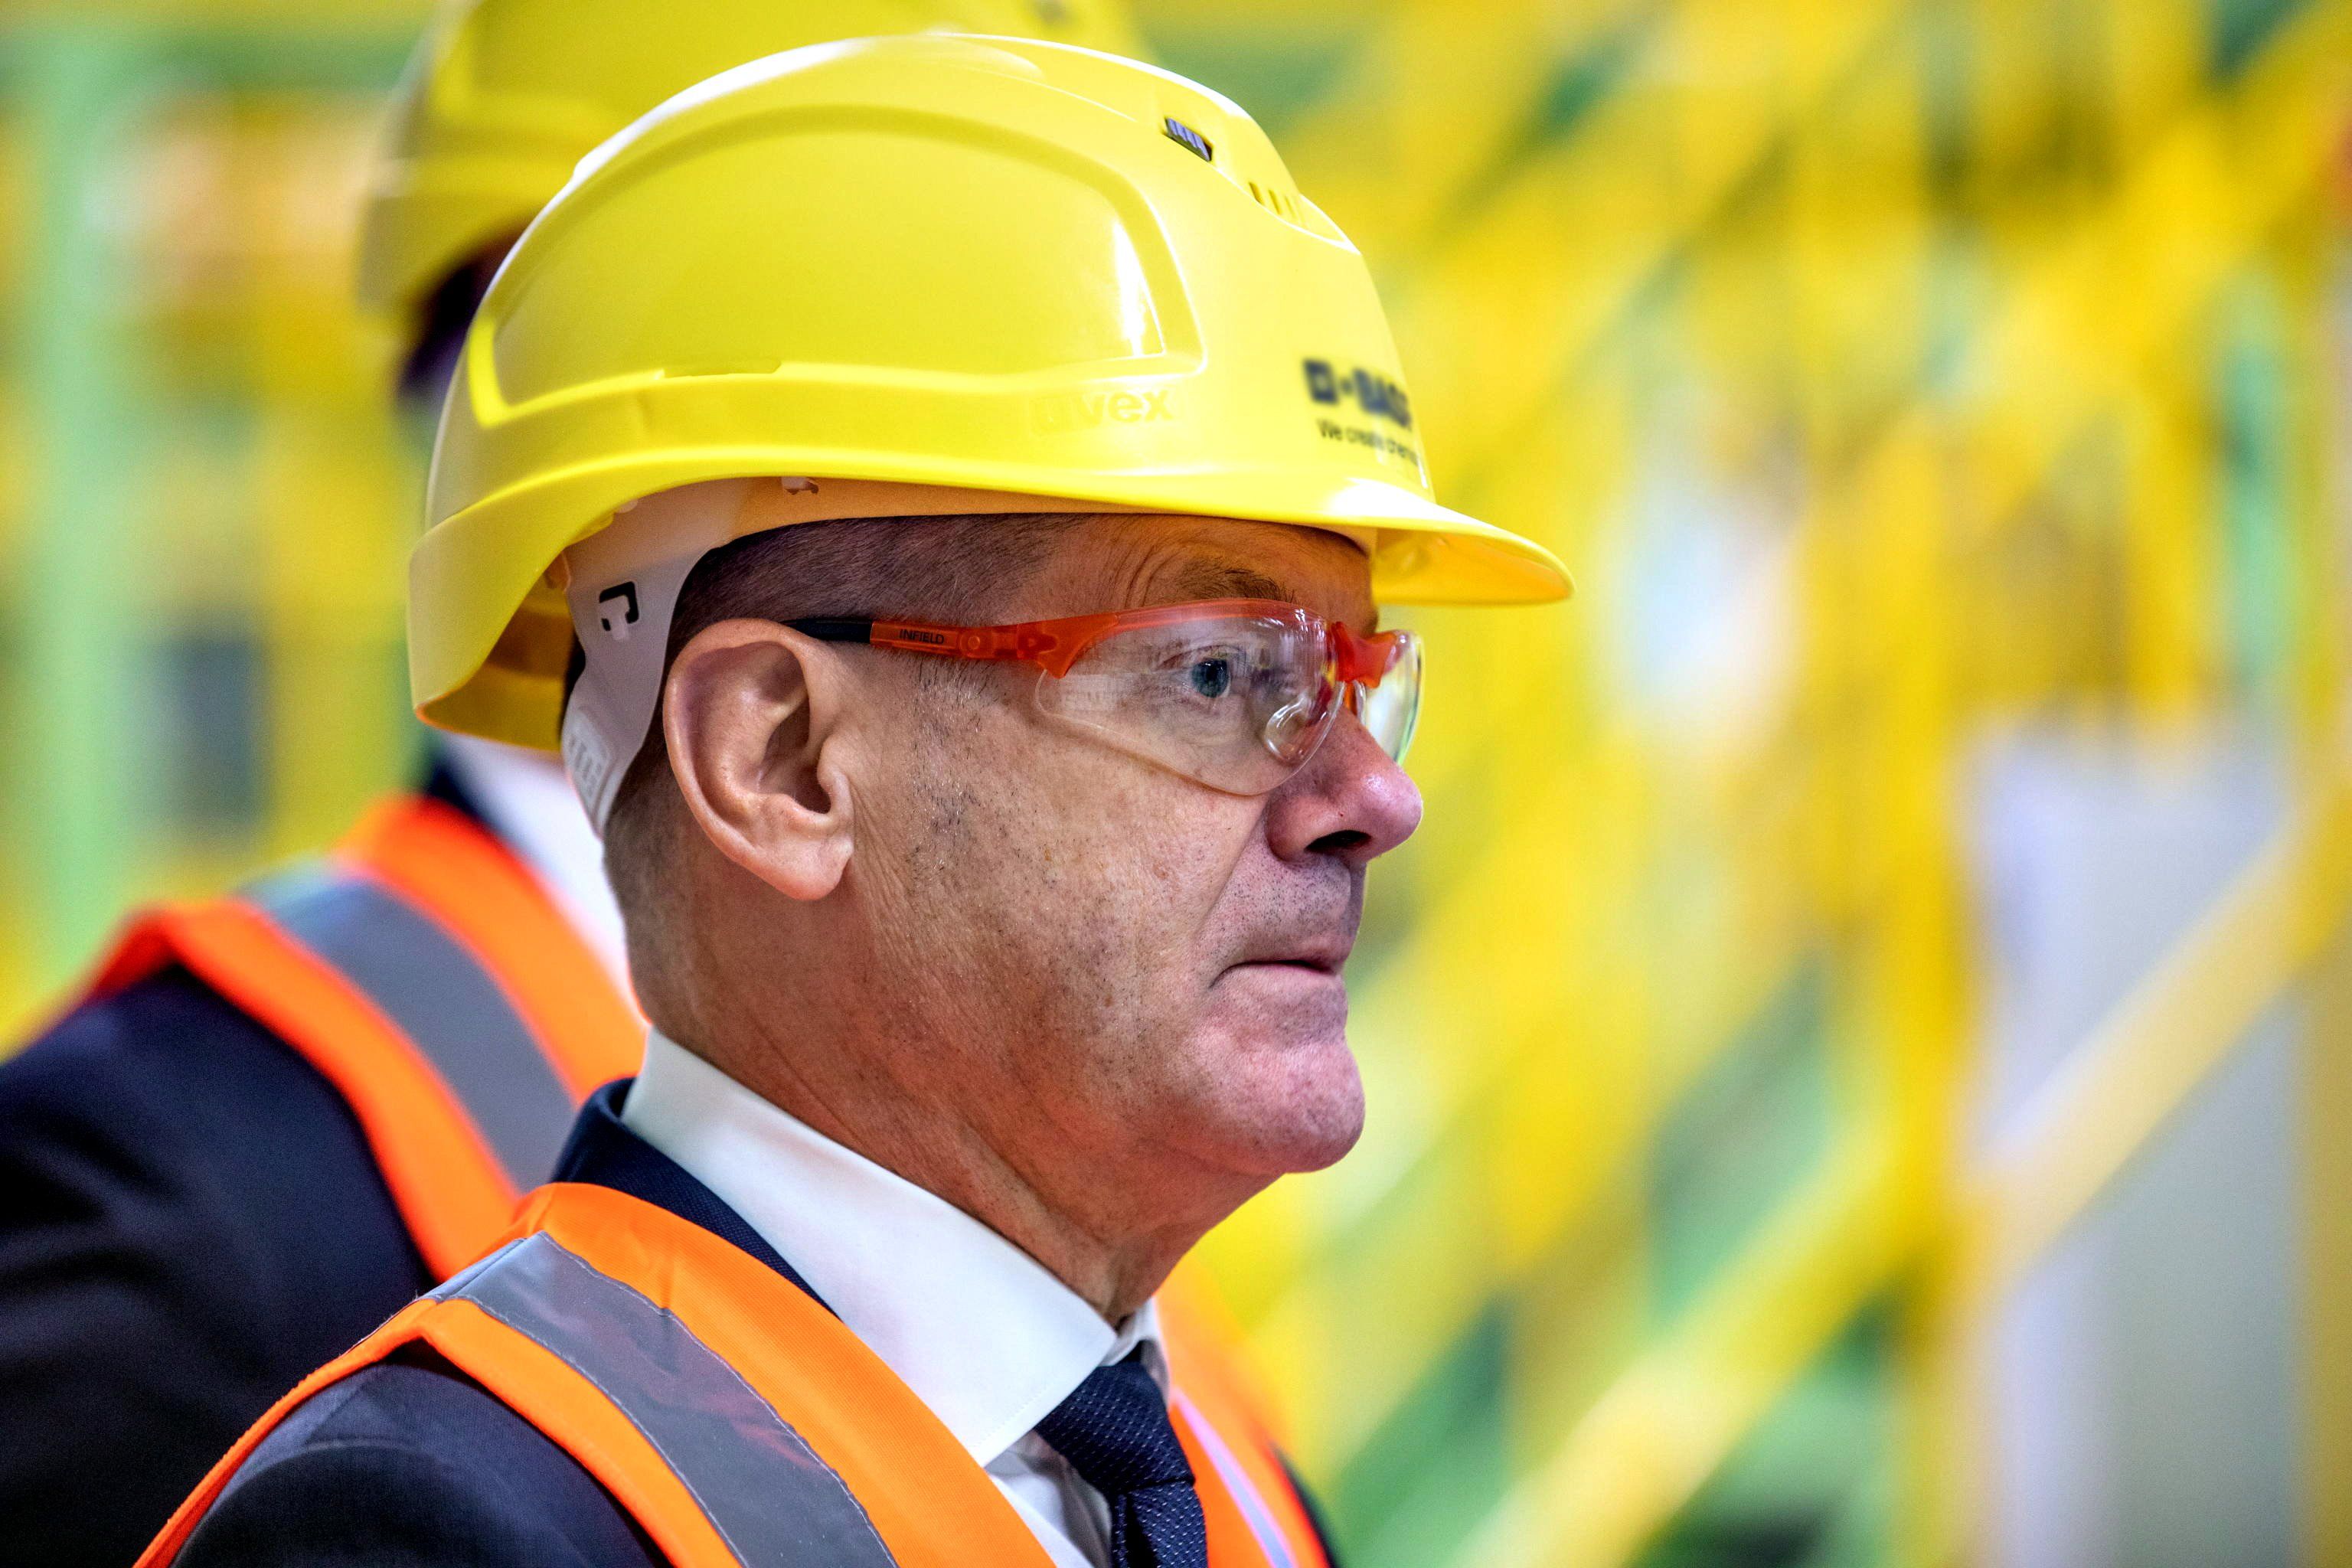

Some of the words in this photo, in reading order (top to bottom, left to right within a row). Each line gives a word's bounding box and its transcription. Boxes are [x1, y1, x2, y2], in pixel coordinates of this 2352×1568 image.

[1030, 390, 1174, 435] uvex
[1353, 367, 1413, 430] BAS
[1316, 418, 1342, 441] We
[899, 629, 944, 645] INFIELD
